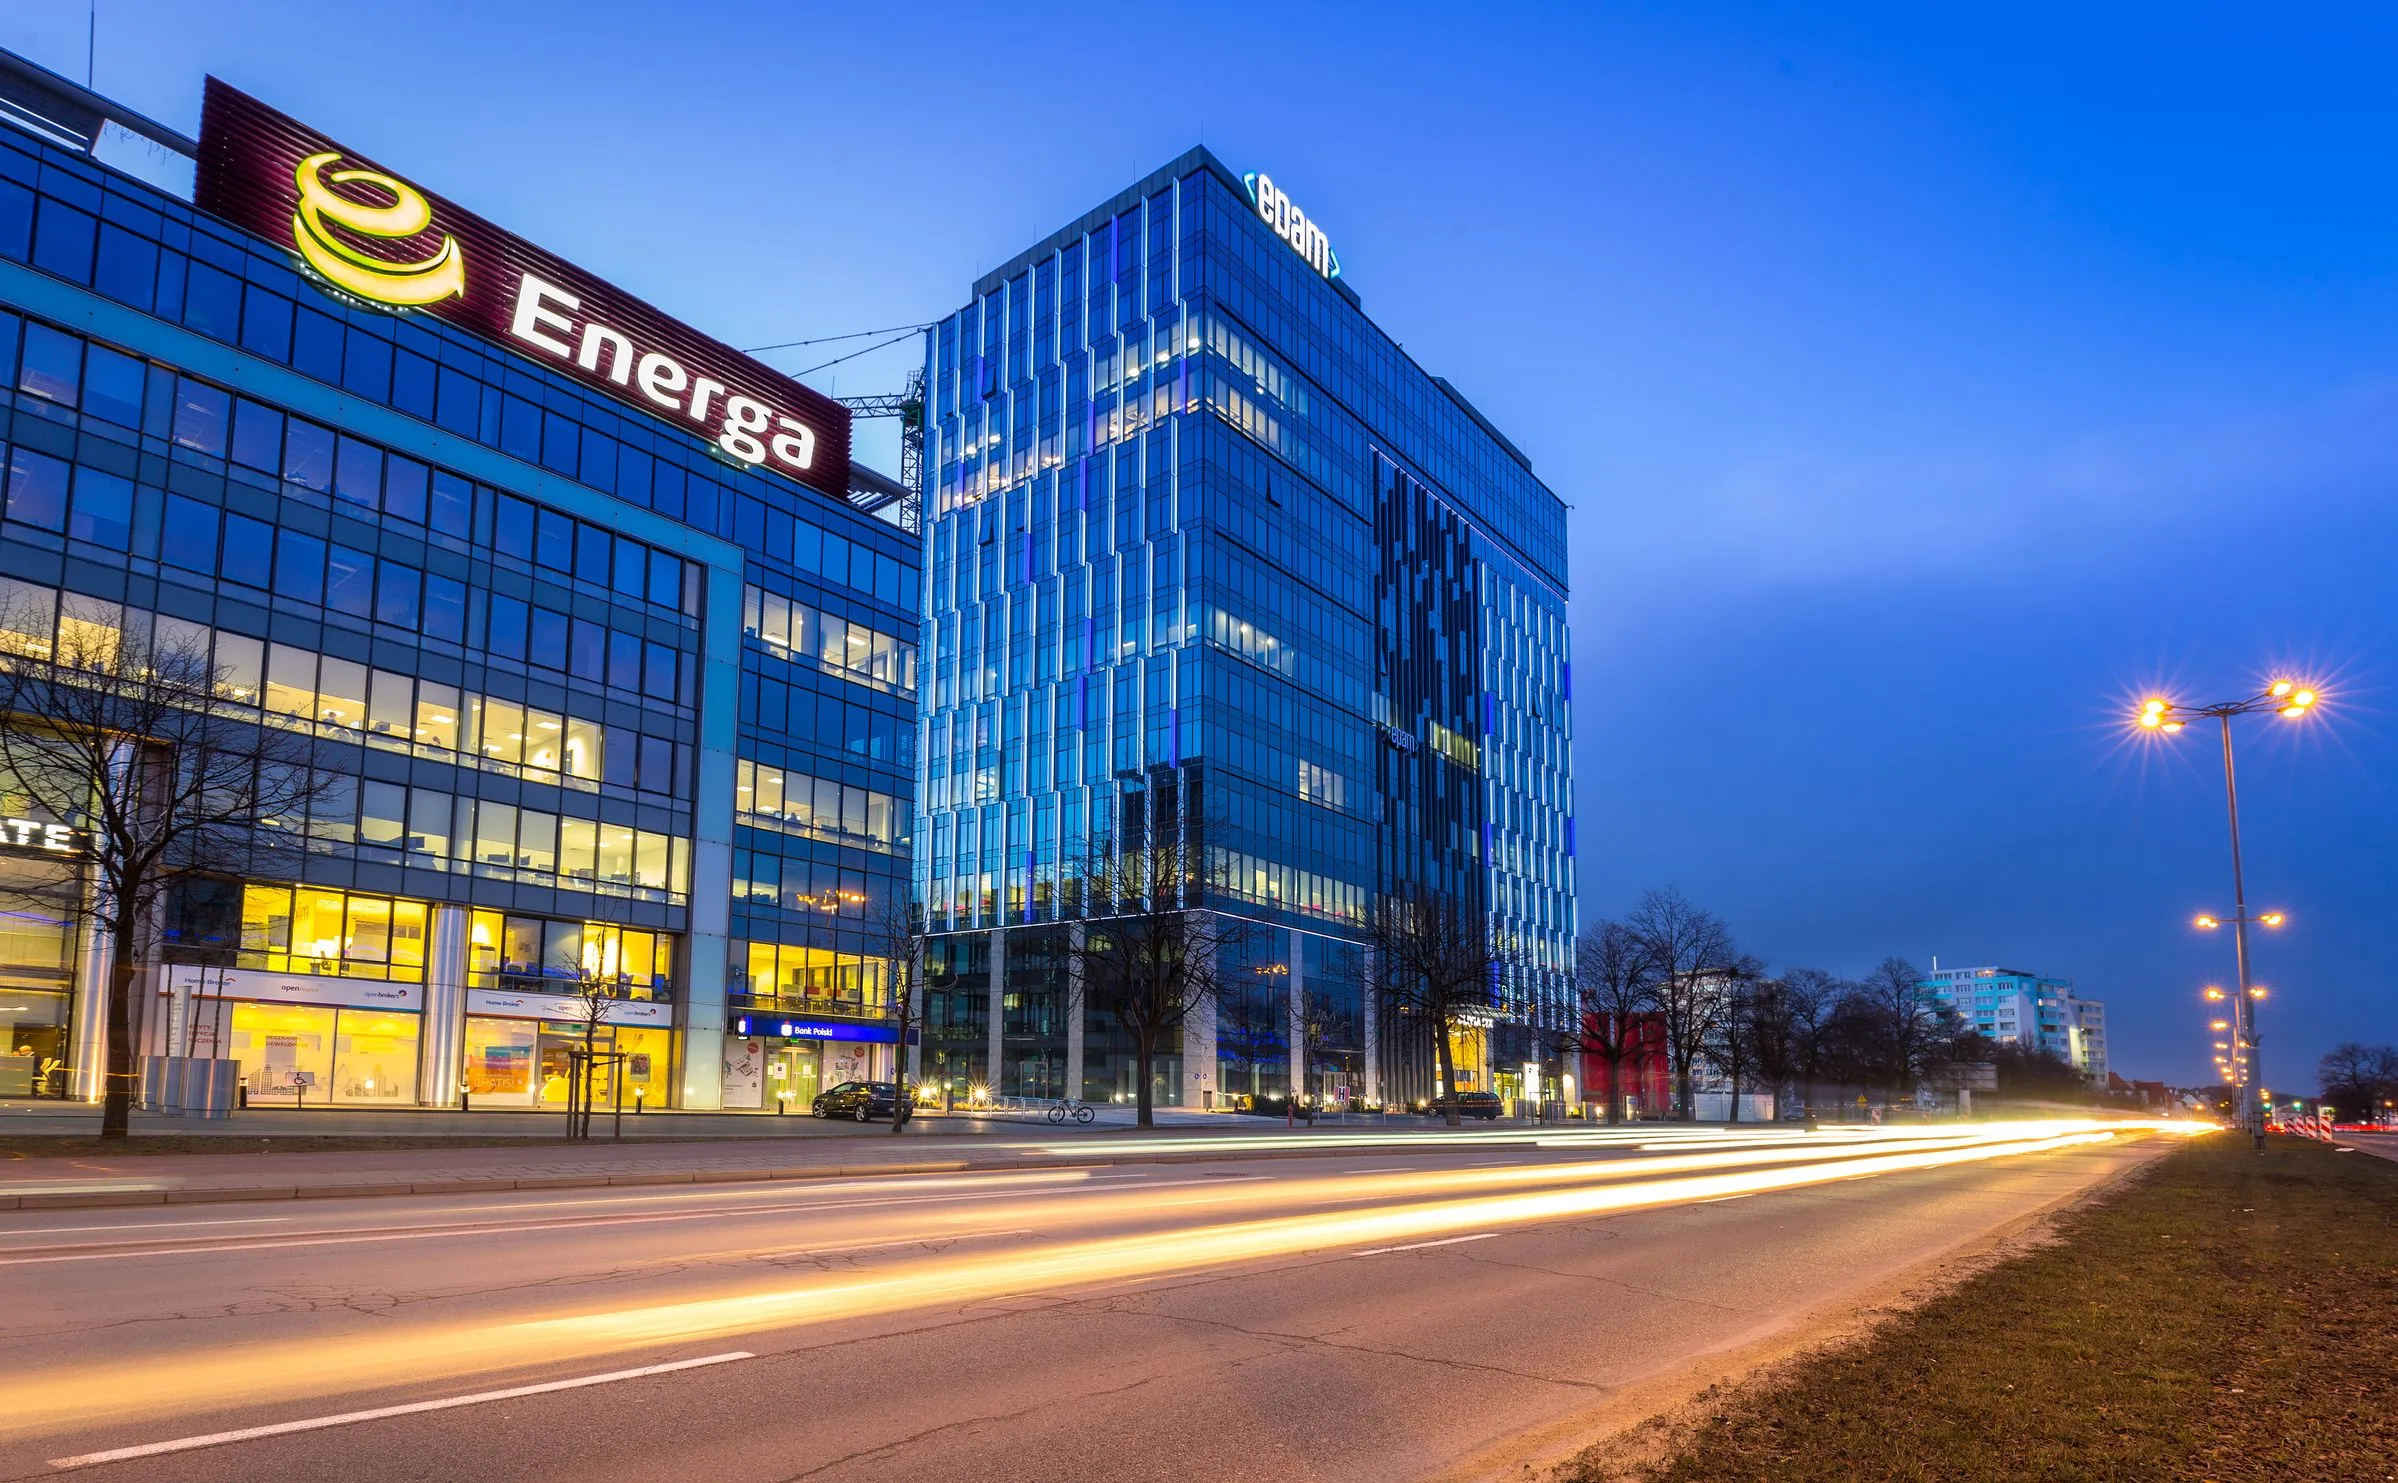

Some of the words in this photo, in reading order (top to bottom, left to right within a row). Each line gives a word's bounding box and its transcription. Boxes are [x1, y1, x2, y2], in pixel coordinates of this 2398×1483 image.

[1258, 173, 1329, 279] epam
[511, 273, 816, 470] Energa
[1391, 726, 1415, 752] epam
[502, 1000, 520, 1008] Broker
[794, 1026, 812, 1035] Bank
[813, 1027, 833, 1036] Polski
